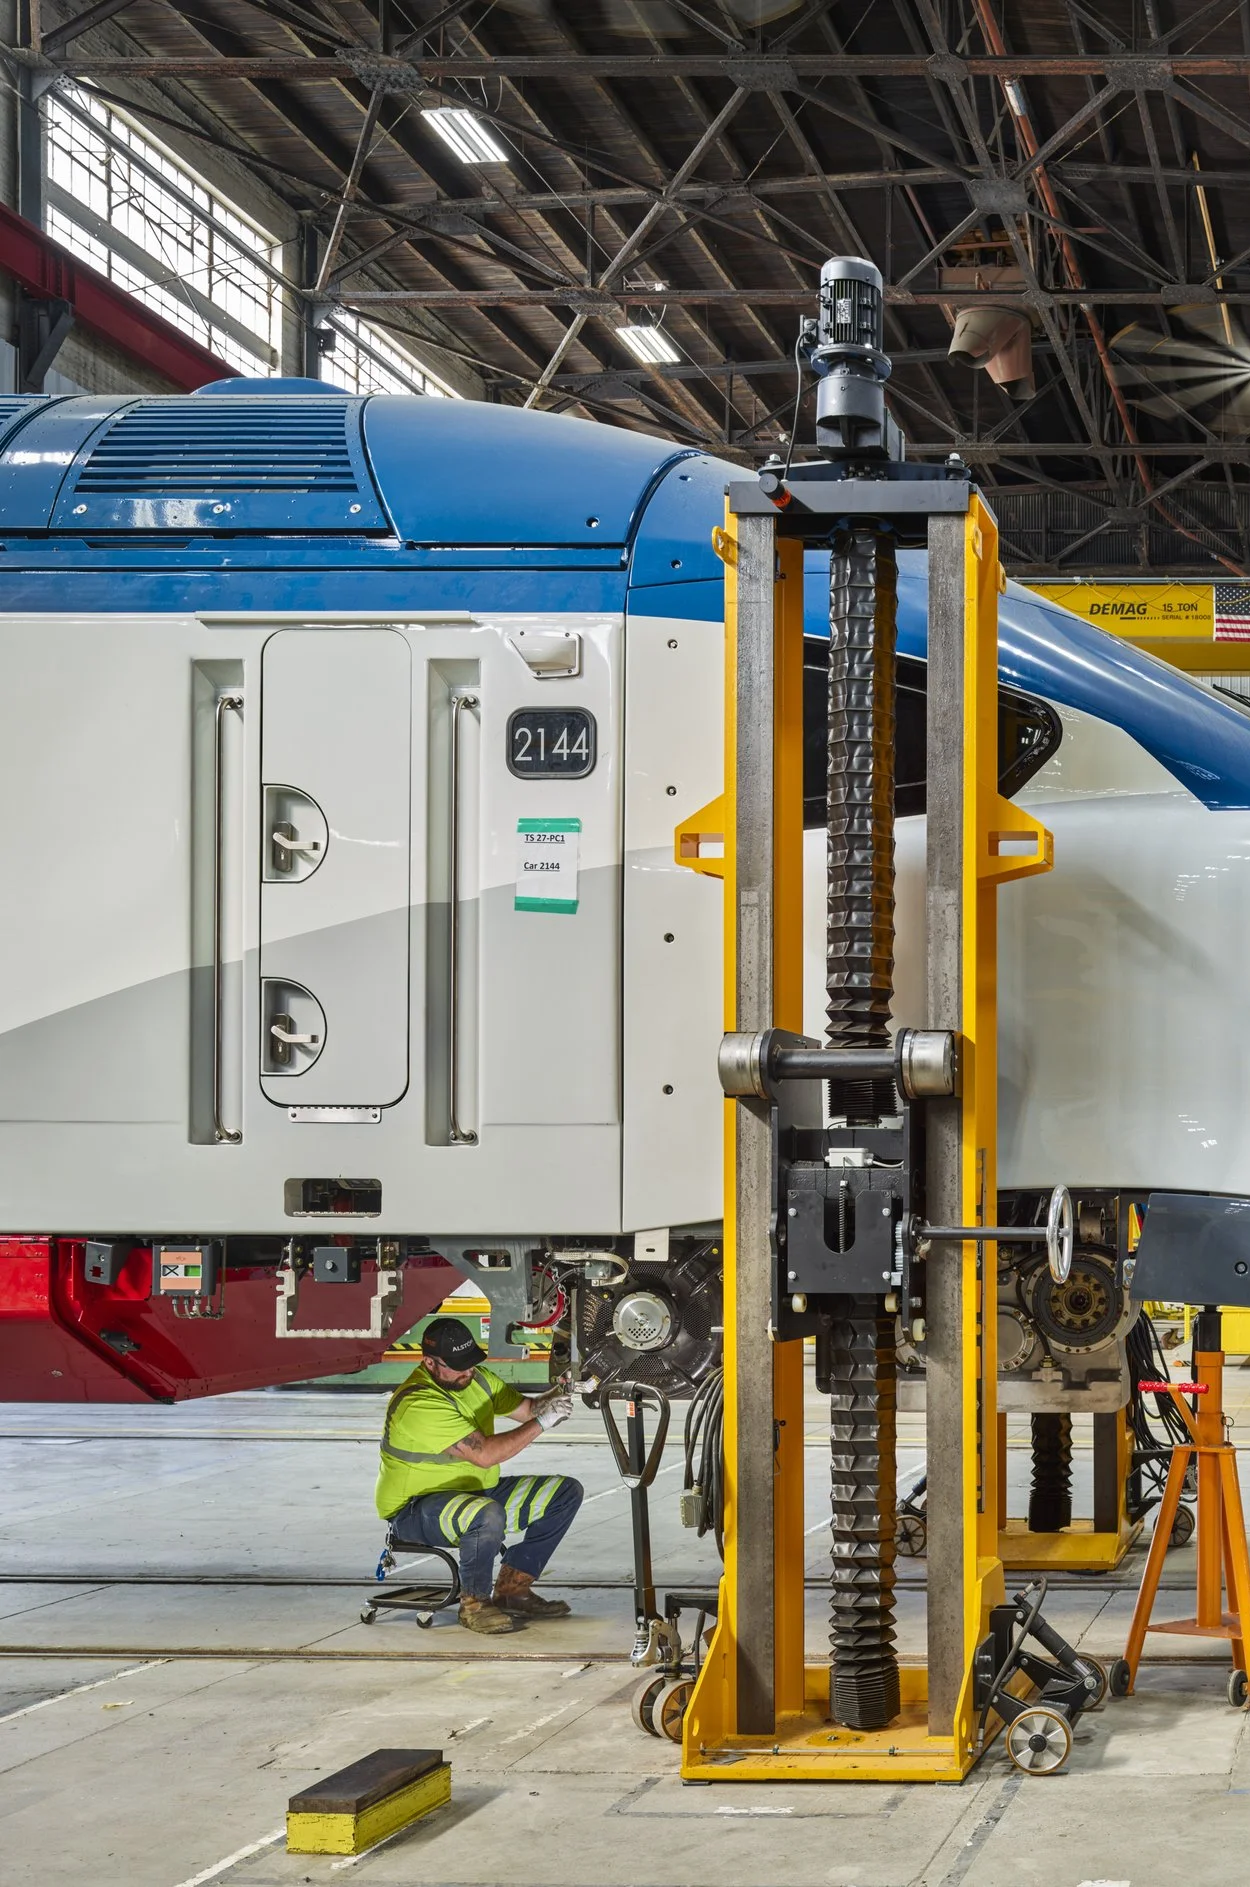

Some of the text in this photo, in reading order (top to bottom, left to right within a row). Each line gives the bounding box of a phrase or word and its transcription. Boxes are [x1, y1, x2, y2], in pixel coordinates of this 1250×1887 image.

[1089, 603, 1147, 615] DEMAG
[1162, 603, 1198, 612] 15 TON
[514, 727, 589, 761] 2144
[524, 834, 565, 843] TS 27-PC1
[524, 861, 560, 870] Car 2144
[452, 1338, 474, 1353] ALSTO
